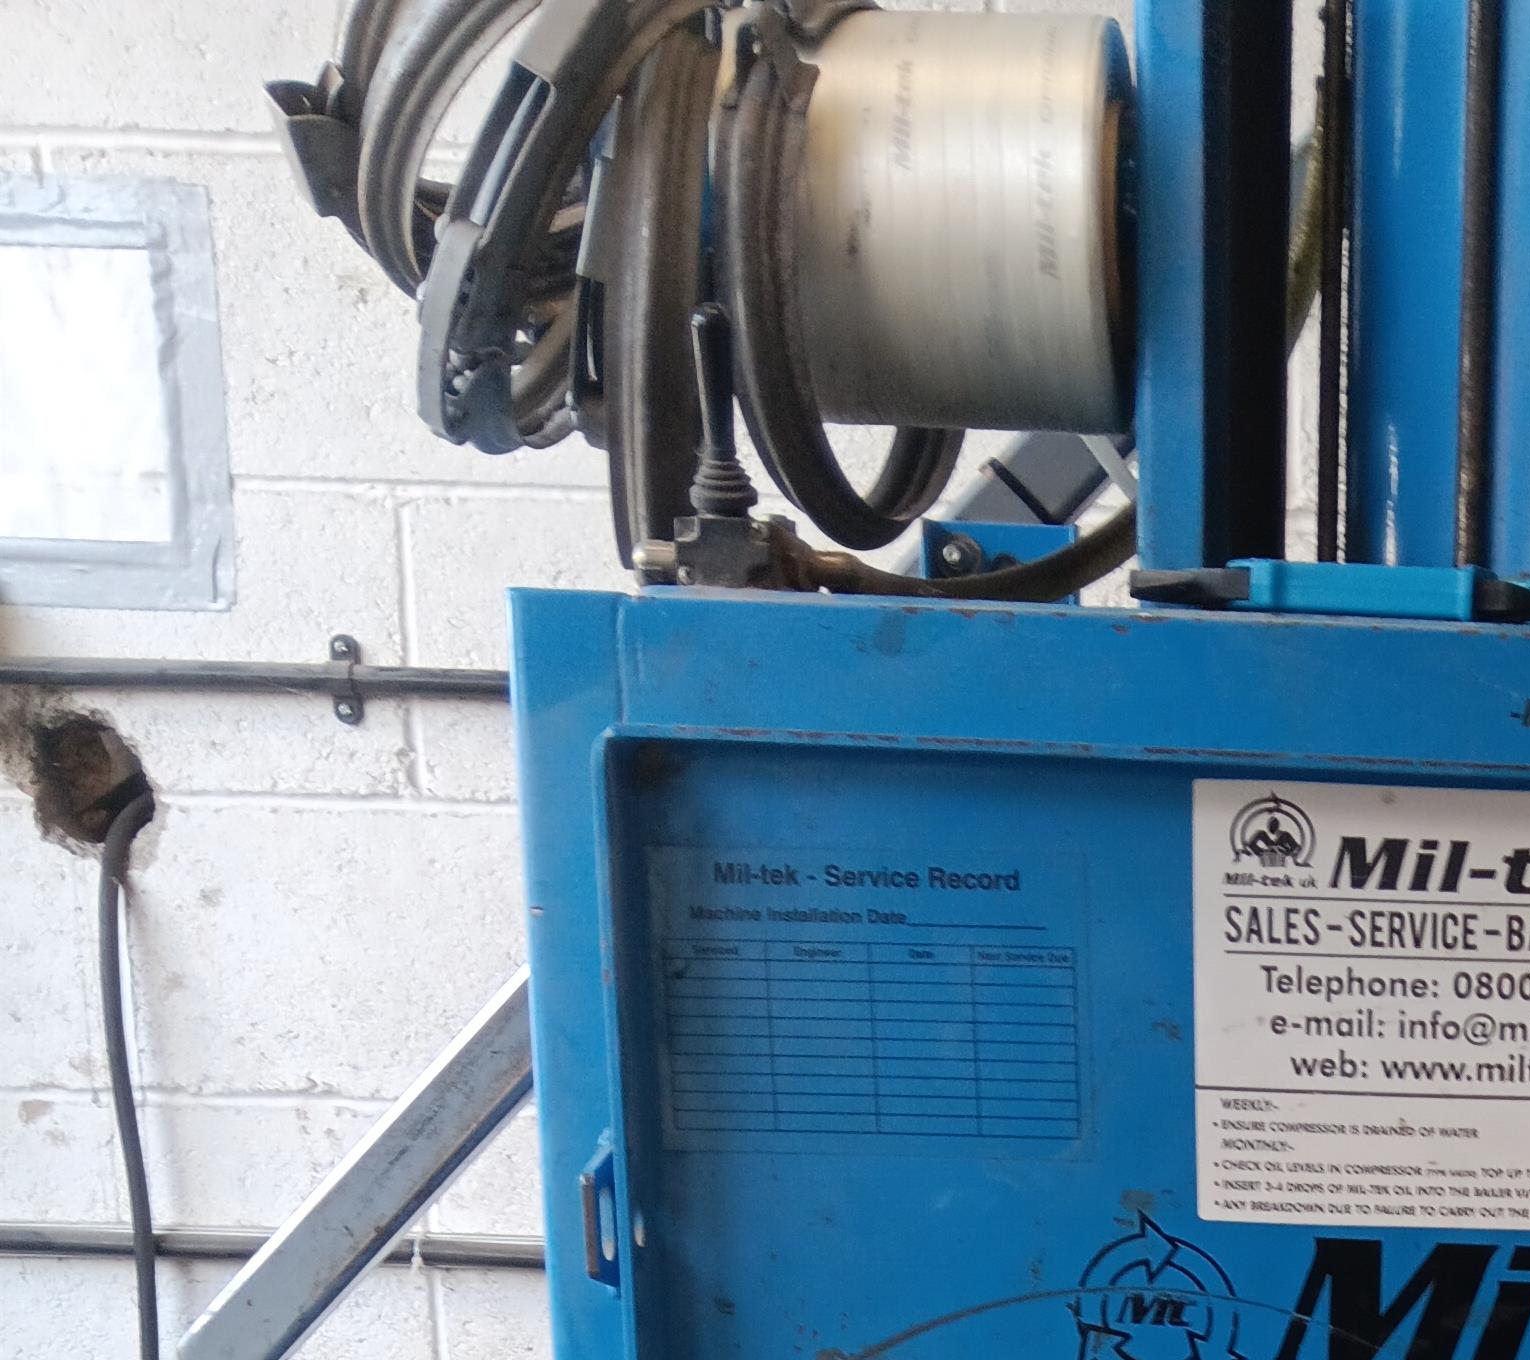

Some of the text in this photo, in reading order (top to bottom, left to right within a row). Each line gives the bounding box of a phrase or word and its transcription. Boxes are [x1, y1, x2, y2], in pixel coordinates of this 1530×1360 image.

[714, 862, 1022, 892] Mil-tek Service Record
[689, 904, 762, 922] Machine
[766, 907, 863, 925] Installation
[1260, 965, 1439, 1001] Telephone:
[1270, 1011, 1386, 1040] e-mail:
[1290, 1051, 1370, 1079] web:
